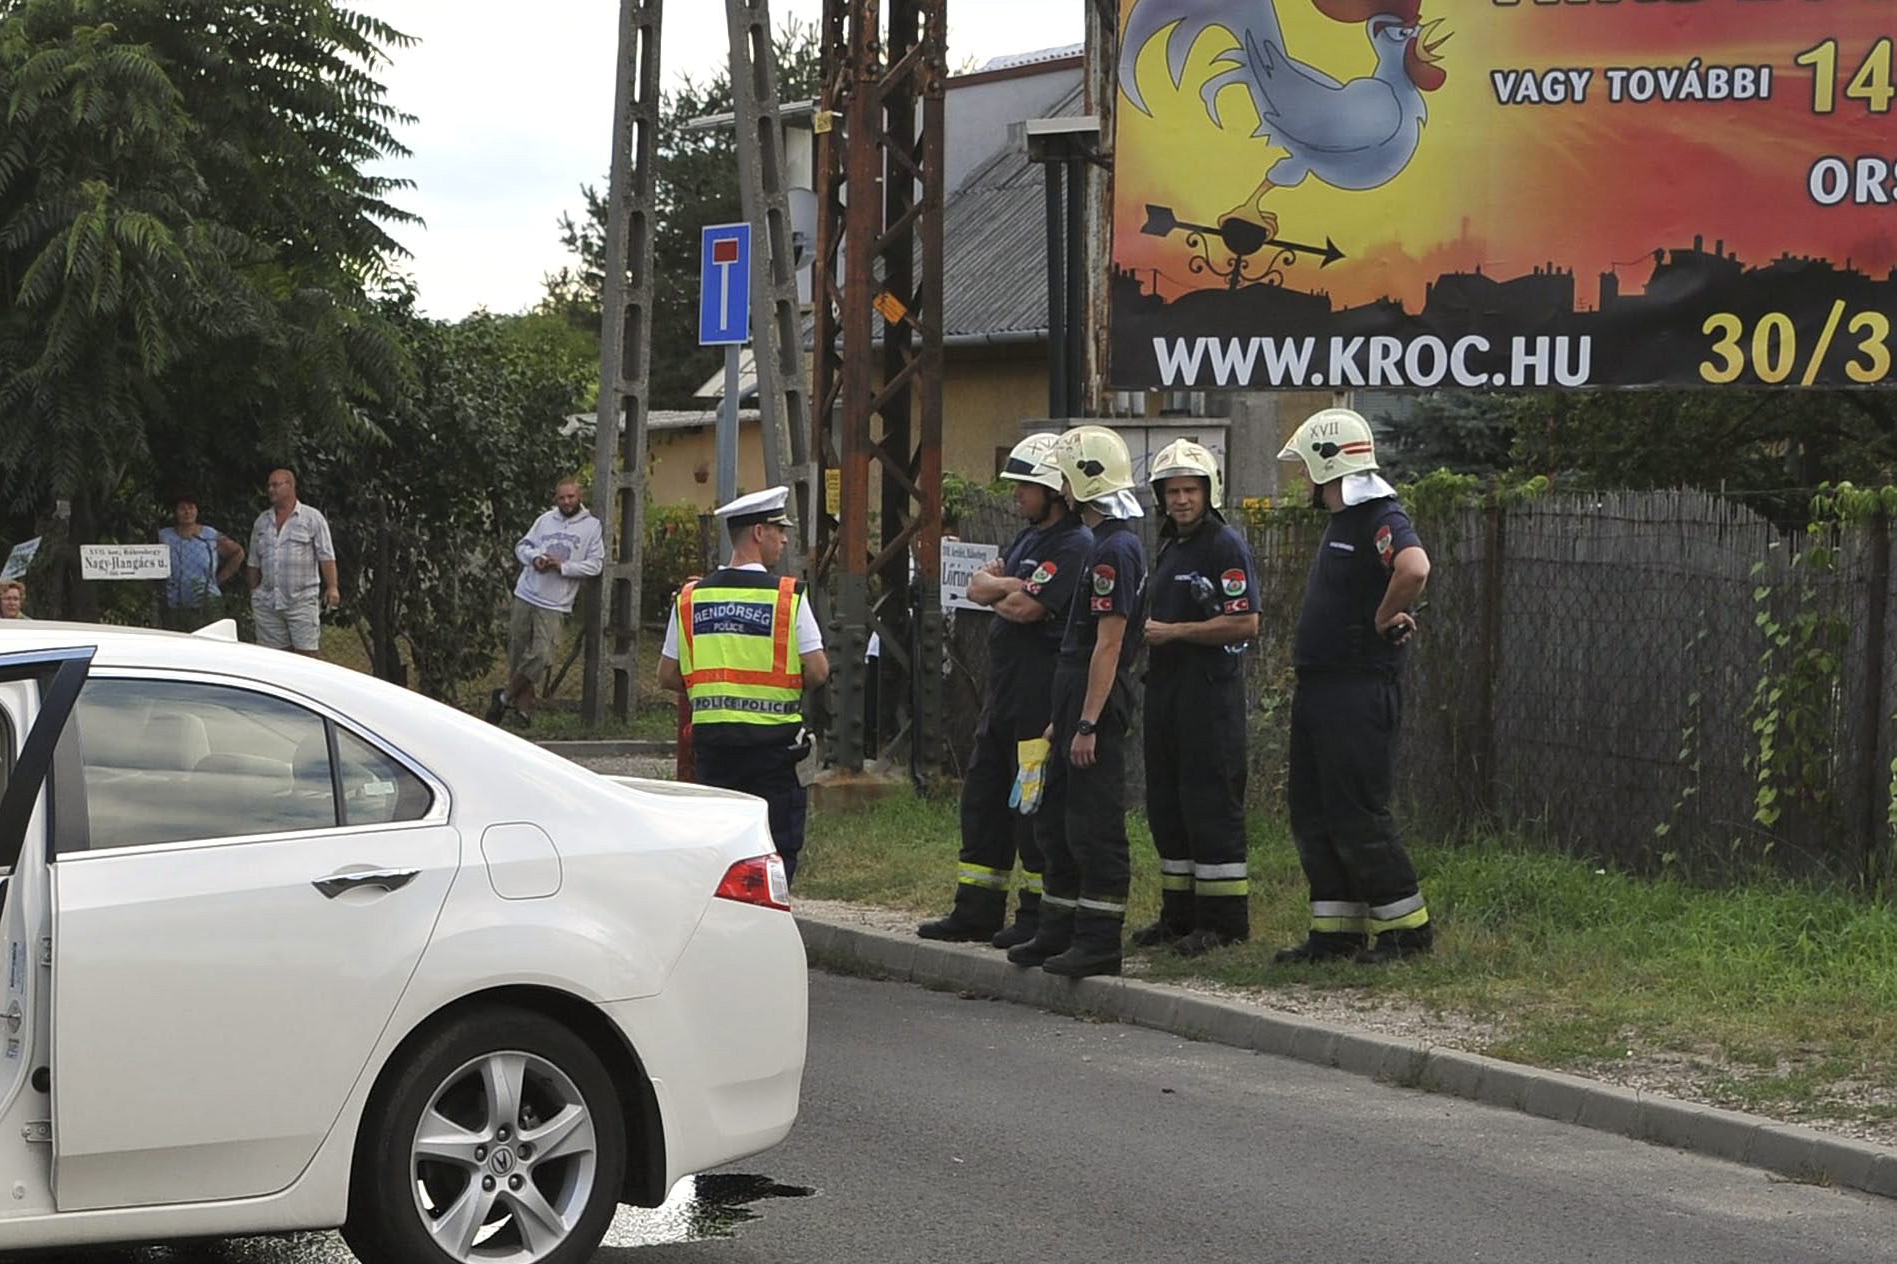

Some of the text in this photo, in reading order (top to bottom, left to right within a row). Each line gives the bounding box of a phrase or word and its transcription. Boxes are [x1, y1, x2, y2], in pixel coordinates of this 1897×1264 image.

[1492, 70, 1592, 103] VAGY
[1606, 60, 1771, 101] TOVÁBBI
[1808, 157, 1897, 205] OR
[1152, 334, 1593, 388] WWW.KROC.HU
[1310, 421, 1339, 440] XVII
[694, 602, 771, 626] RENDŐRSÉG
[713, 621, 745, 632] POLICE
